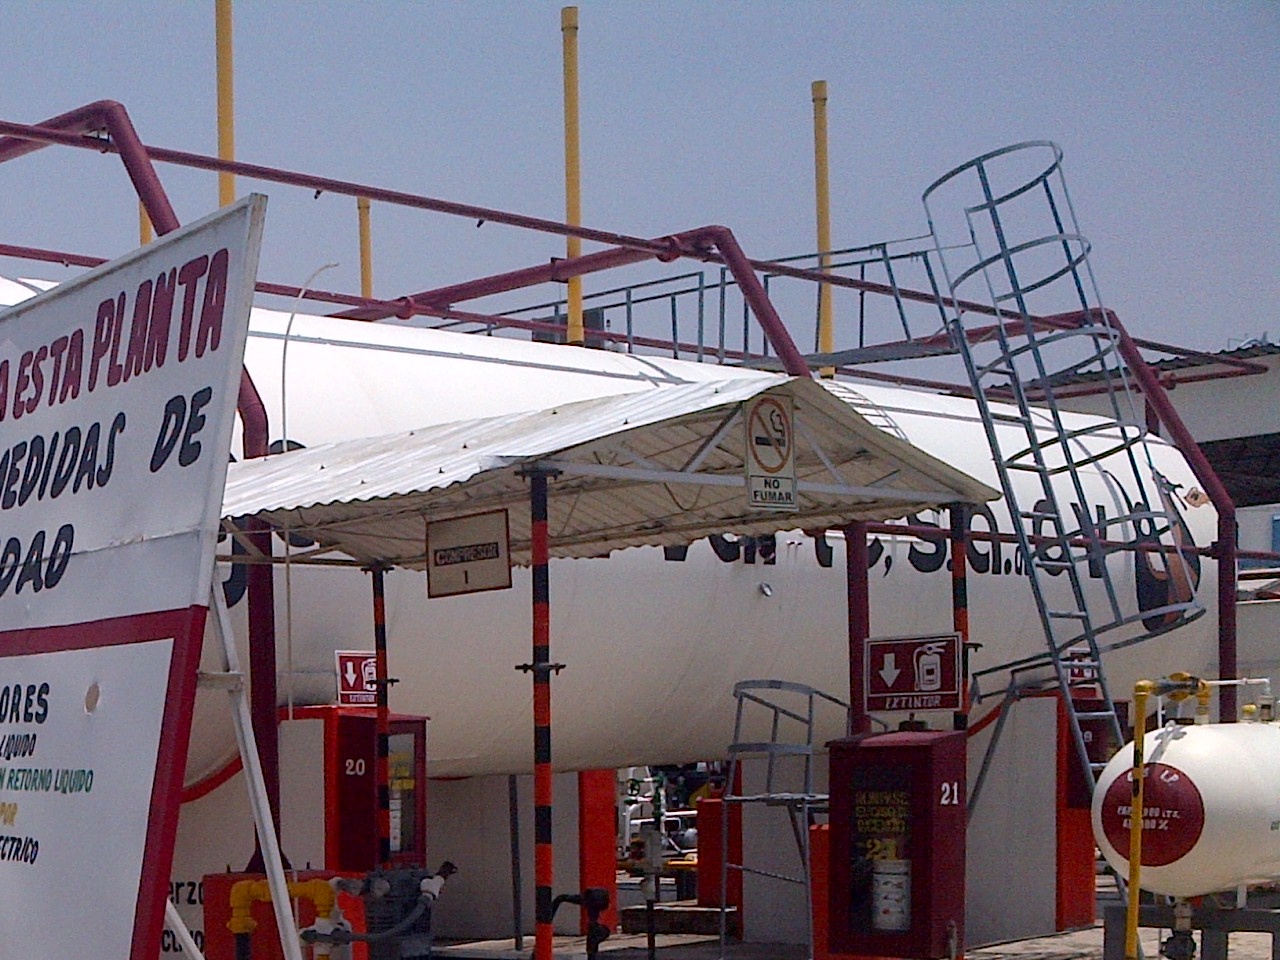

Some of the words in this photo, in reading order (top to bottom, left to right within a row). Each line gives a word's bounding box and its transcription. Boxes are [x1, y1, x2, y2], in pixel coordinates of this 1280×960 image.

[13, 328, 84, 419] ESTA
[88, 248, 229, 392] PLANTA
[150, 386, 212, 472] DE
[764, 478, 780, 489] NO
[754, 490, 792, 502] FUMAR
[464, 569, 468, 585] 1
[886, 695, 942, 709] EXTINTOR
[345, 758, 366, 776] 20
[6, 768, 53, 792] RETORNO
[54, 769, 94, 794] LIQUIDO
[940, 782, 959, 805] 21
